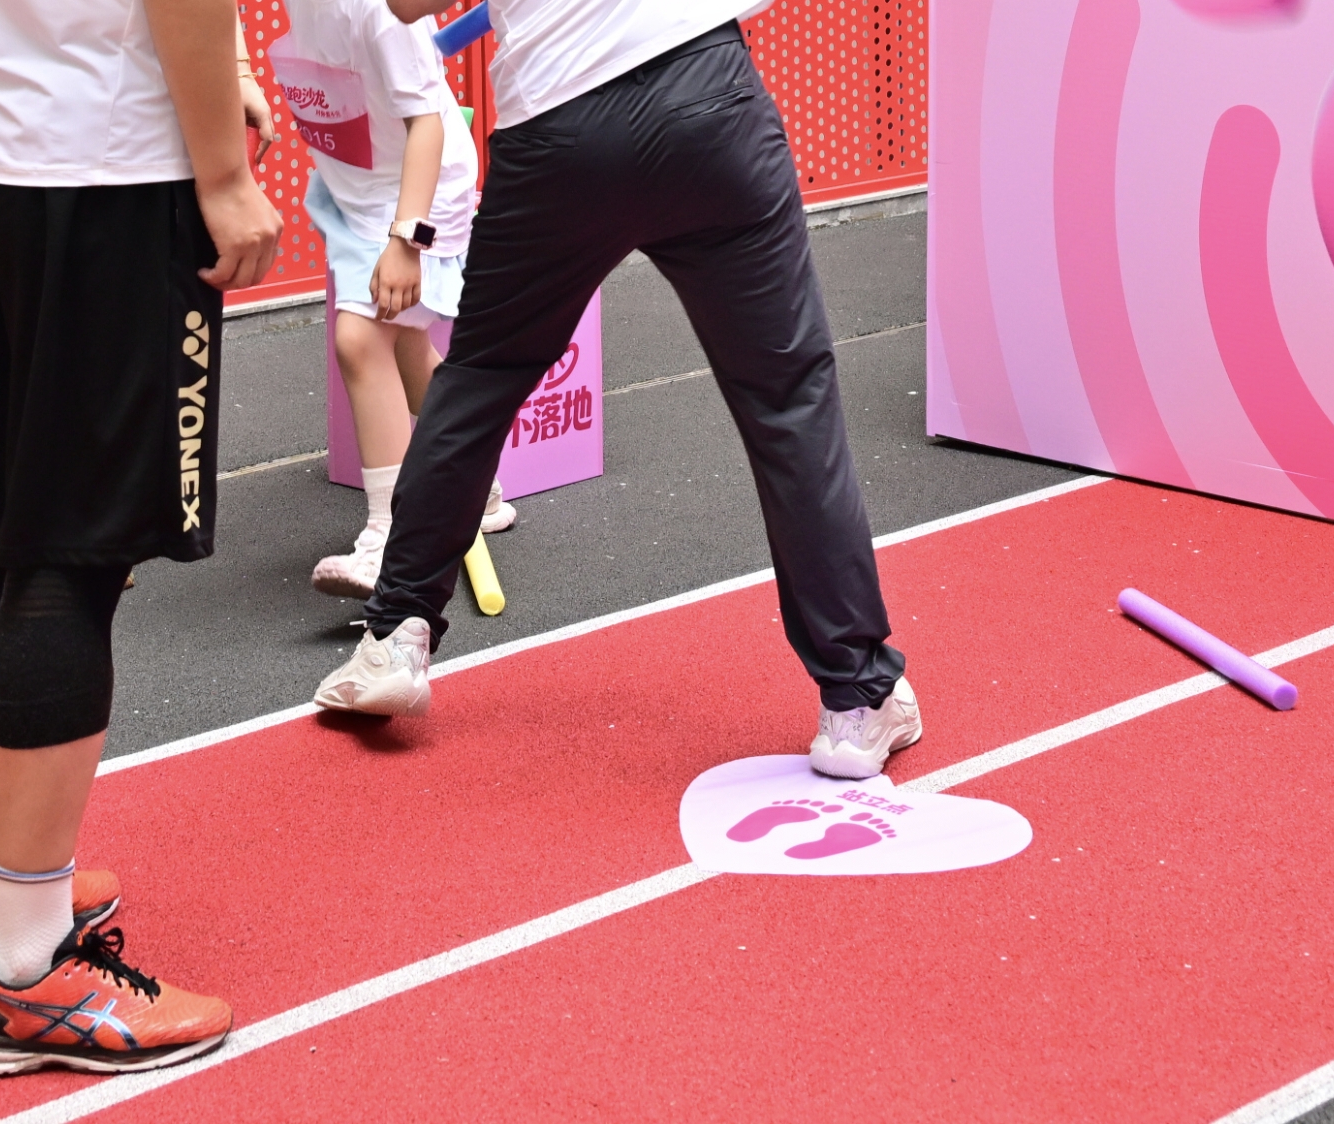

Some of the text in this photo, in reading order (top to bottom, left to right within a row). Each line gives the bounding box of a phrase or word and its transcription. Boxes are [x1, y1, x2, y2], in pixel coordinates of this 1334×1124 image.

[178, 375, 208, 533] YONEX
[835, 788, 914, 816] 站立点
